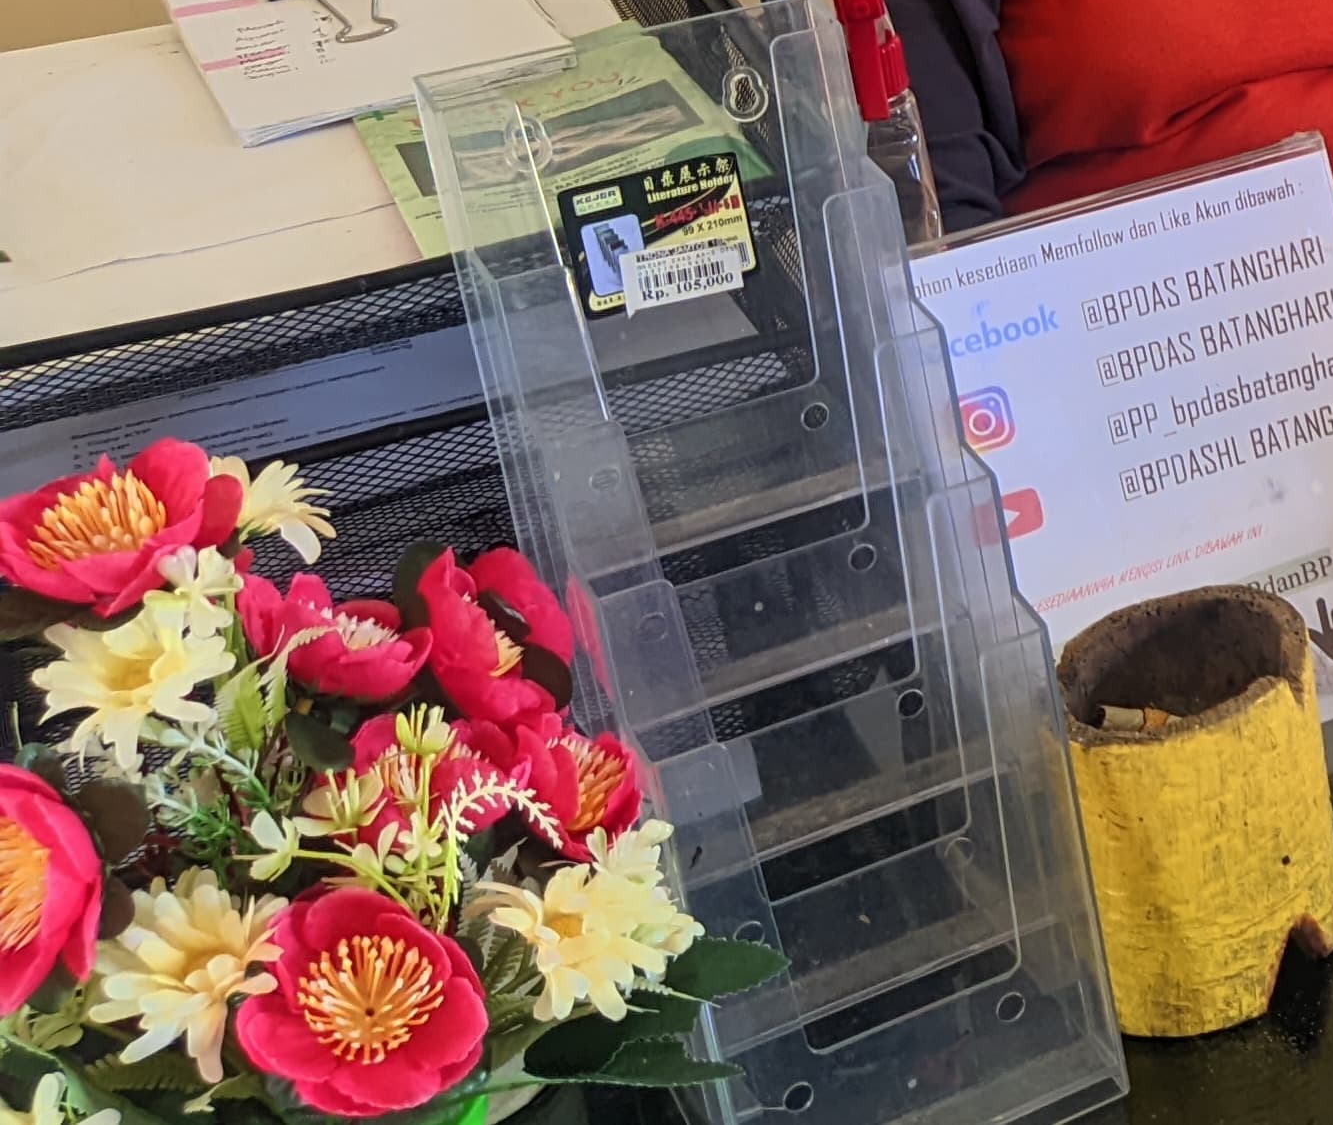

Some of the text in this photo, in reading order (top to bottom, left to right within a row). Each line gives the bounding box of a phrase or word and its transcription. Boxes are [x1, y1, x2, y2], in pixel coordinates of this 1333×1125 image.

[646, 173, 734, 204] Literature Holder
[706, 214, 743, 230] 210mm
[913, 180, 1296, 301] ohon kesediaan Memfollow dan Like Akun dibawah
[641, 288, 670, 302] Rp.
[675, 272, 735, 295] 105,000
[1080, 234, 1326, 332] @BPDAS BATANGHARI
[949, 303, 1060, 358] cebook
[1095, 331, 1197, 388] @BPDAS
[1118, 436, 1247, 502] @BPDASHL
